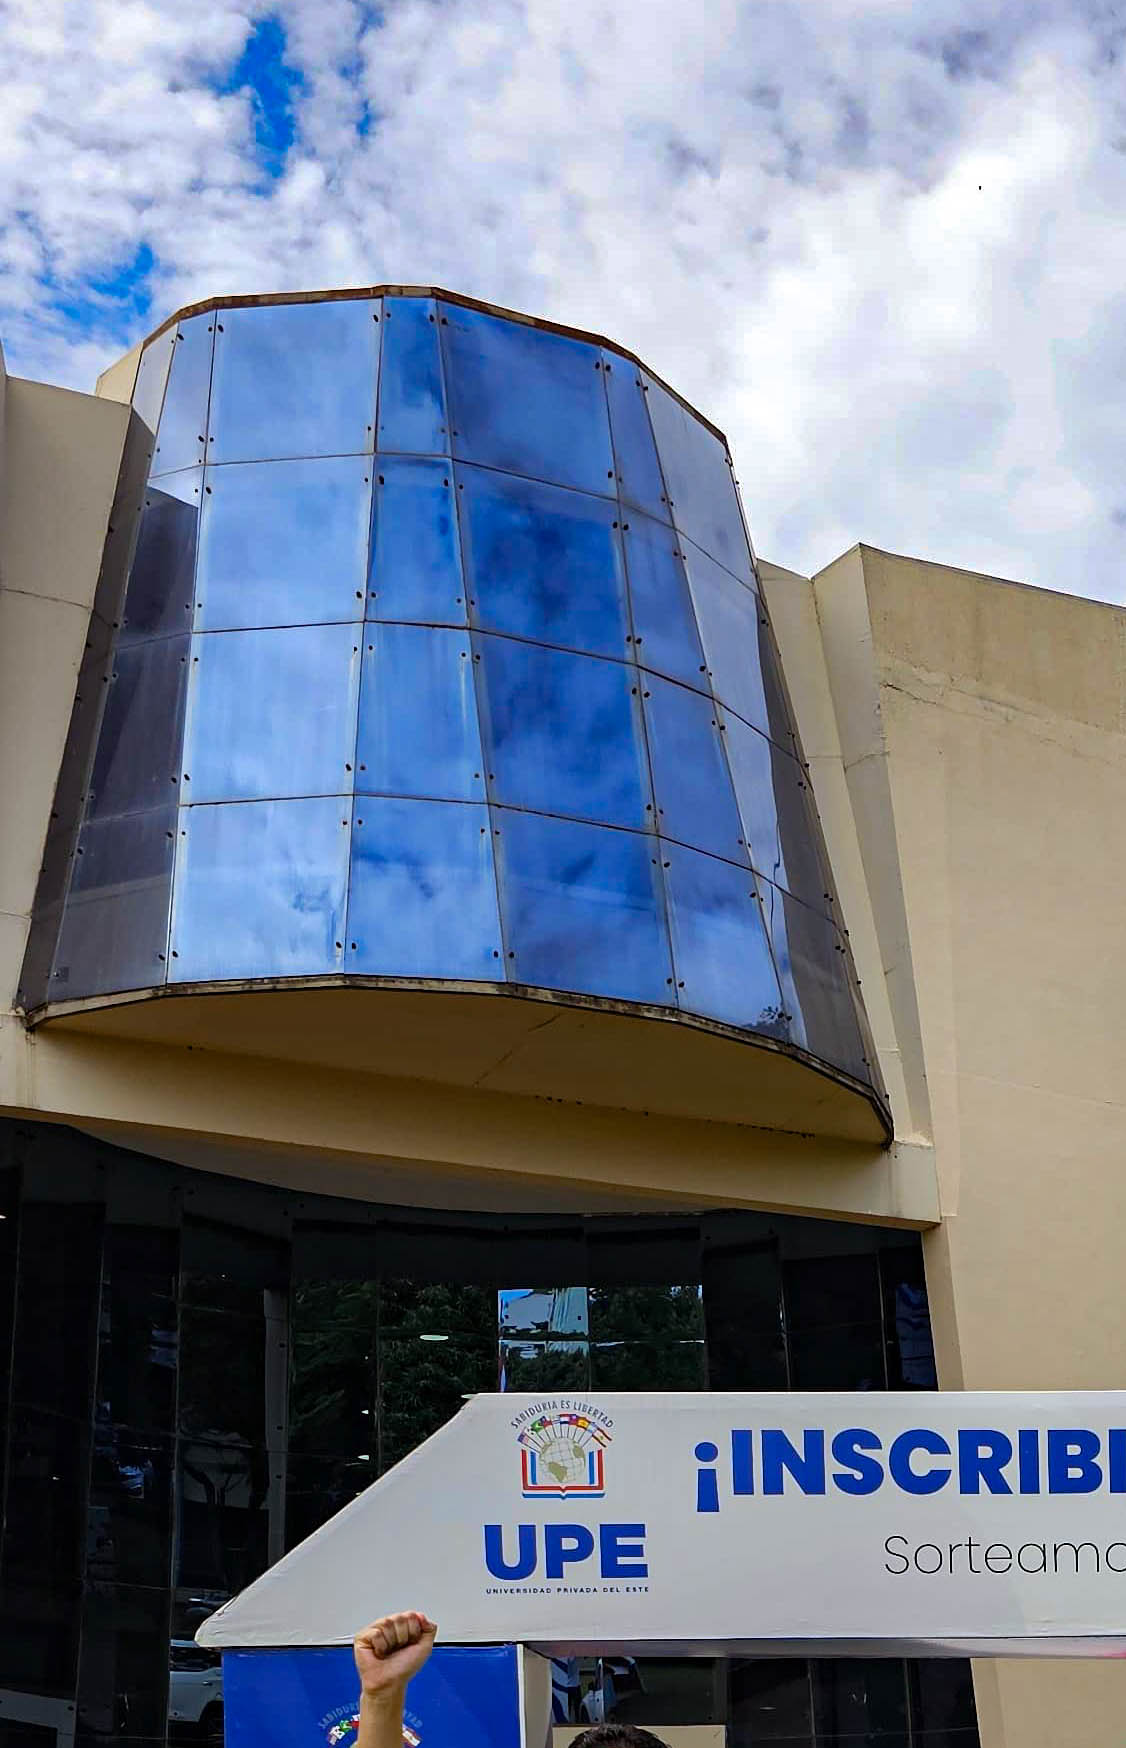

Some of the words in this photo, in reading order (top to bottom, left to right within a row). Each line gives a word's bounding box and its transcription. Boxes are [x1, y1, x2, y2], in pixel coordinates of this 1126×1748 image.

[510, 1400, 558, 1429] SABIDURIA
[560, 1399, 570, 1409] ES
[573, 1401, 614, 1429] LIBERTAD
[484, 1523, 648, 1580] UPE
